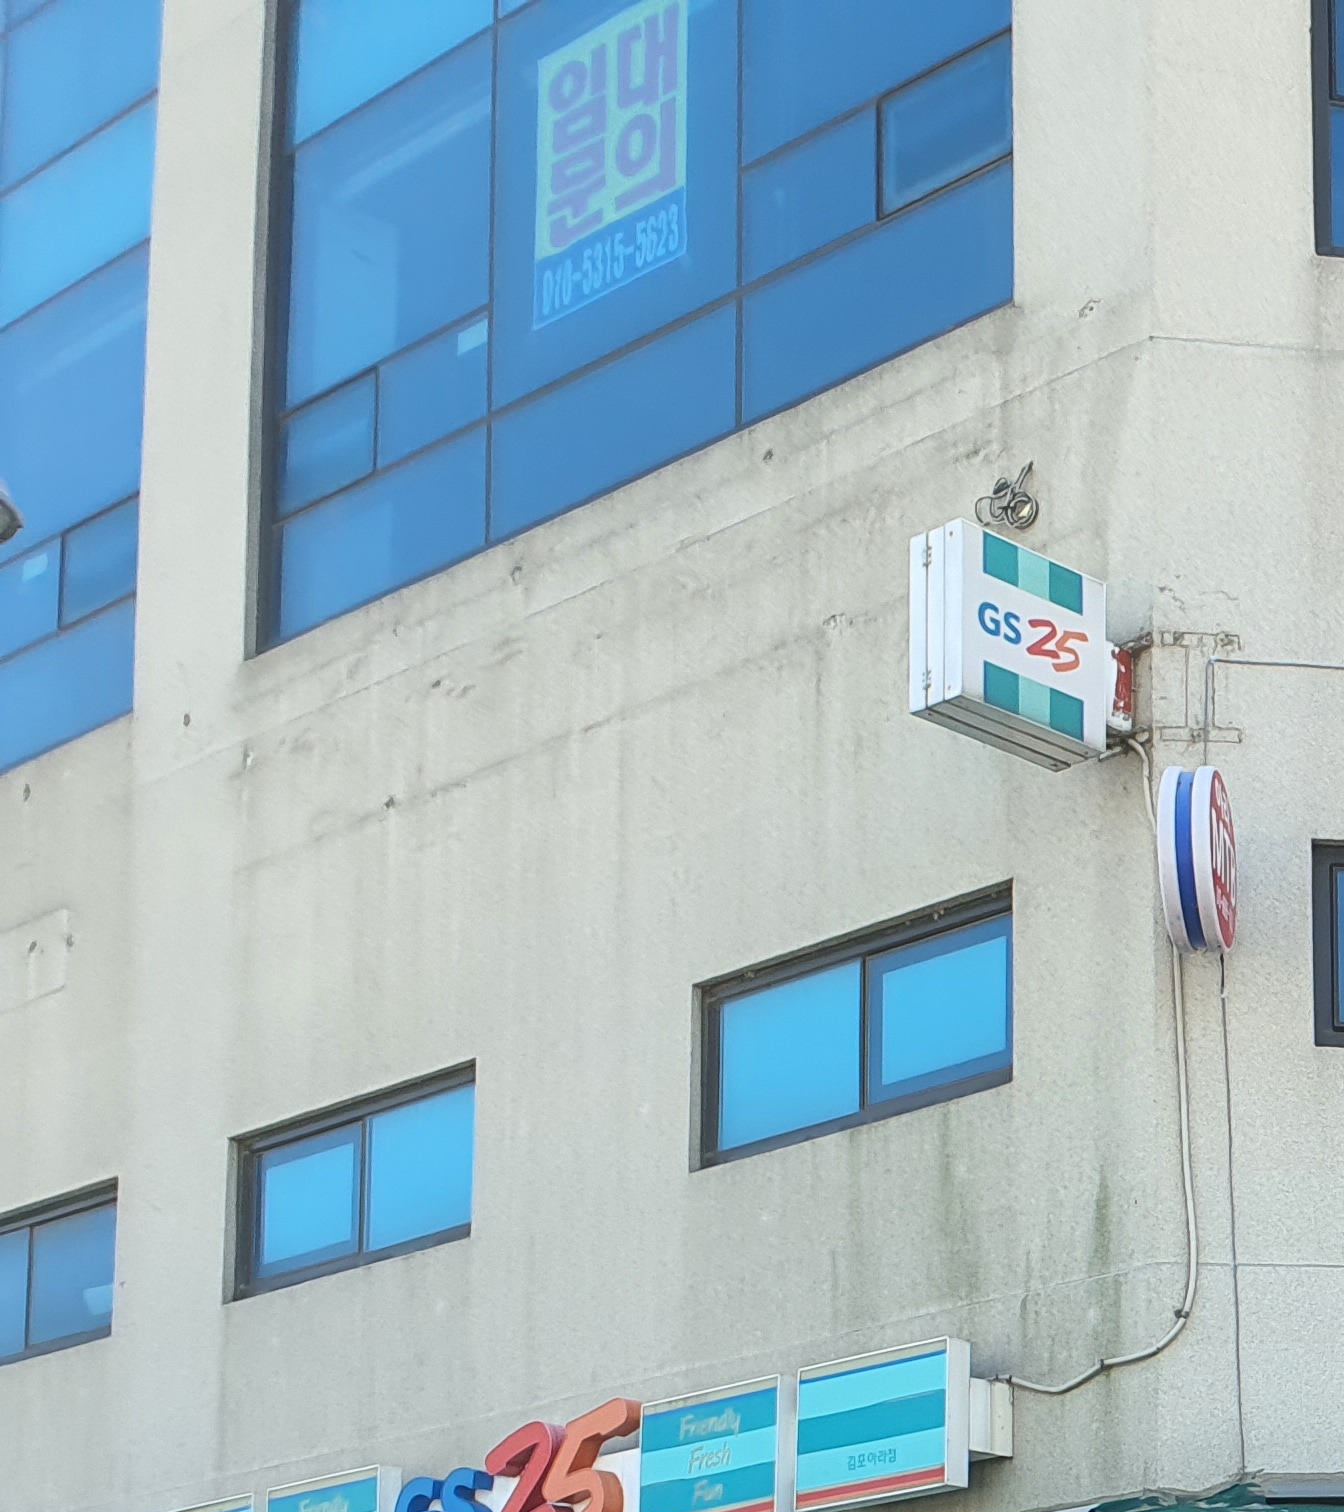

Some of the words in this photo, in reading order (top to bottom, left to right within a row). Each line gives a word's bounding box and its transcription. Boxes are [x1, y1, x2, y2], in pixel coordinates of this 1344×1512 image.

[549, 2, 680, 155] 임대
[547, 96, 677, 249] 문의
[542, 203, 679, 316] 010-5315-5623
[977, 600, 1089, 673] GS25
[679, 1407, 741, 1442] Friendly
[688, 1440, 732, 1474] Fresh
[692, 1478, 723, 1507] Fun
